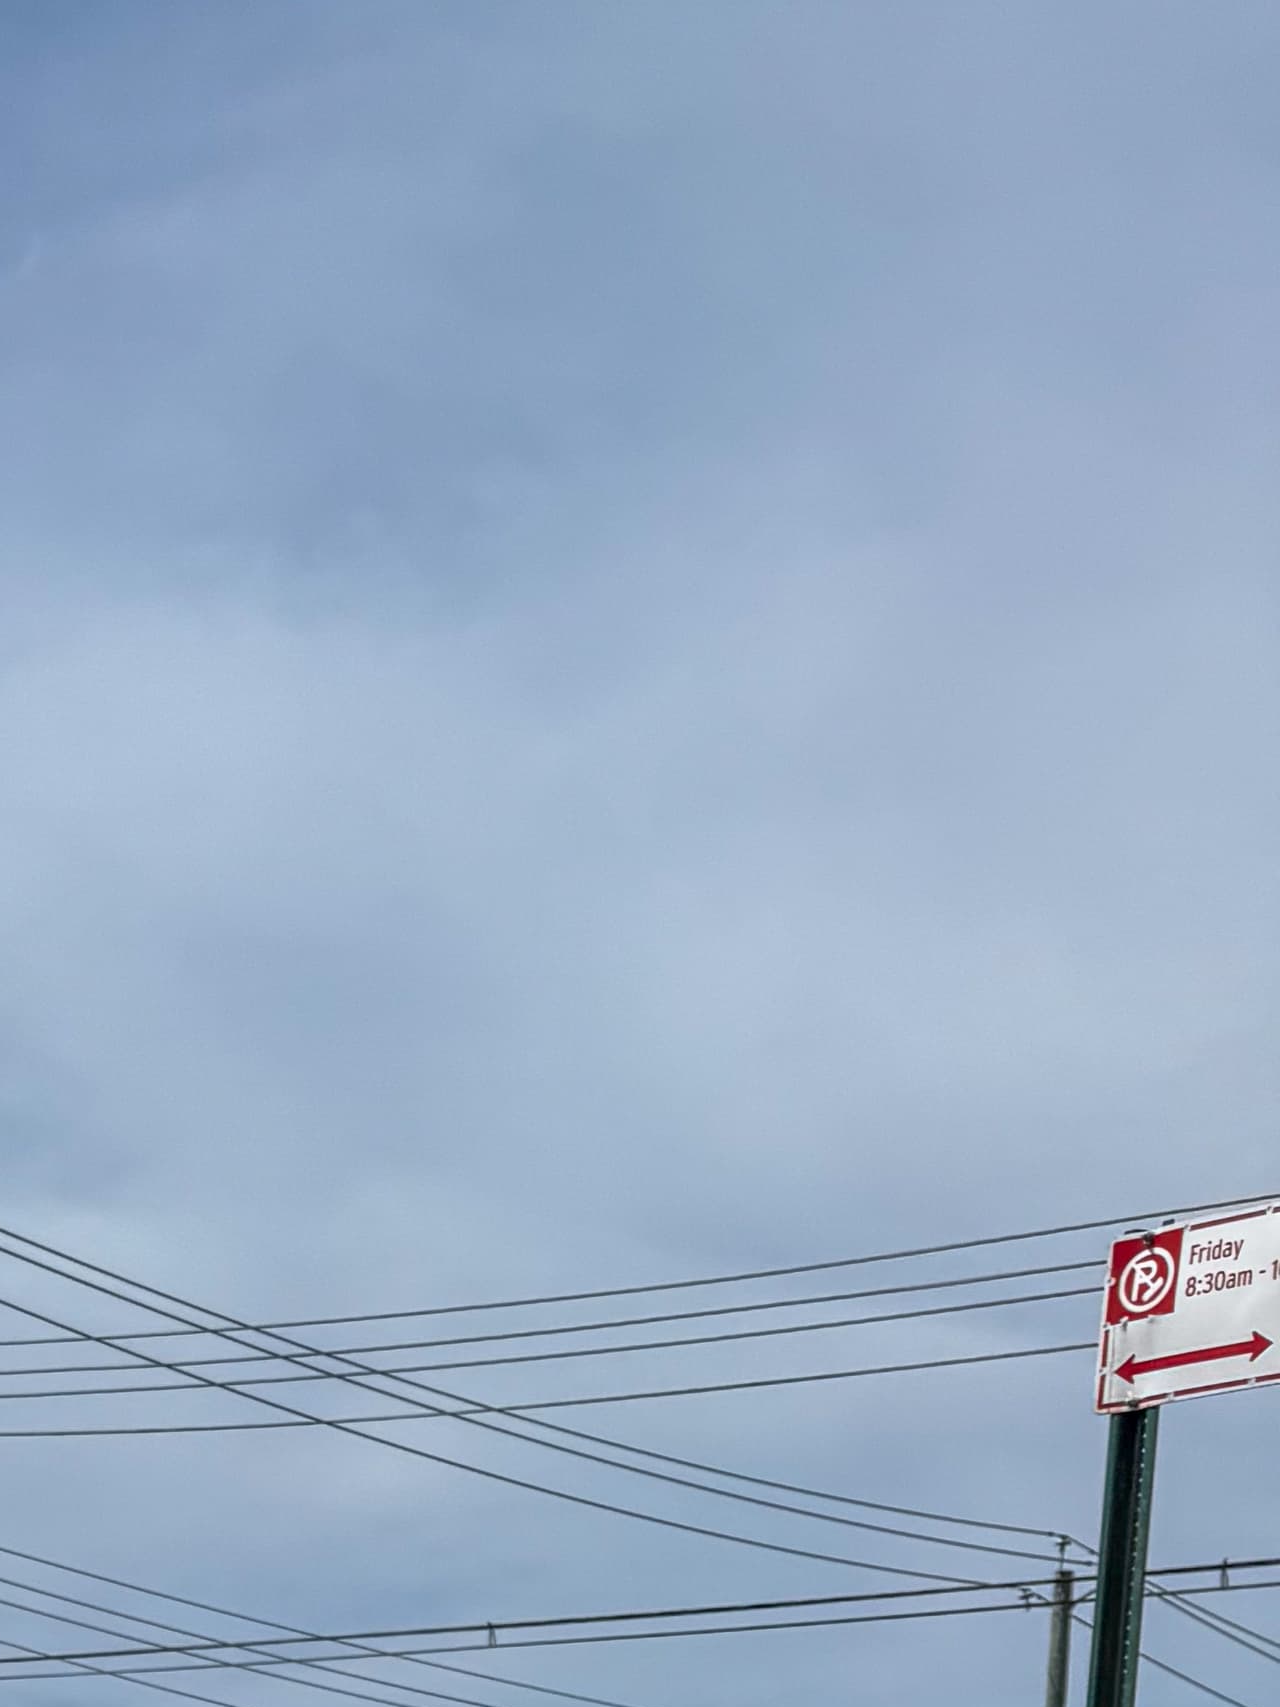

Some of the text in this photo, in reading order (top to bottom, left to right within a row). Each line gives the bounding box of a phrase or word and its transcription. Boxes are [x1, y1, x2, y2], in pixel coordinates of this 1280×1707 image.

[1189, 1238, 1244, 1265] Friday
[1185, 1267, 1253, 1298] 8:30am
[1271, 1258, 1280, 1281] 1
